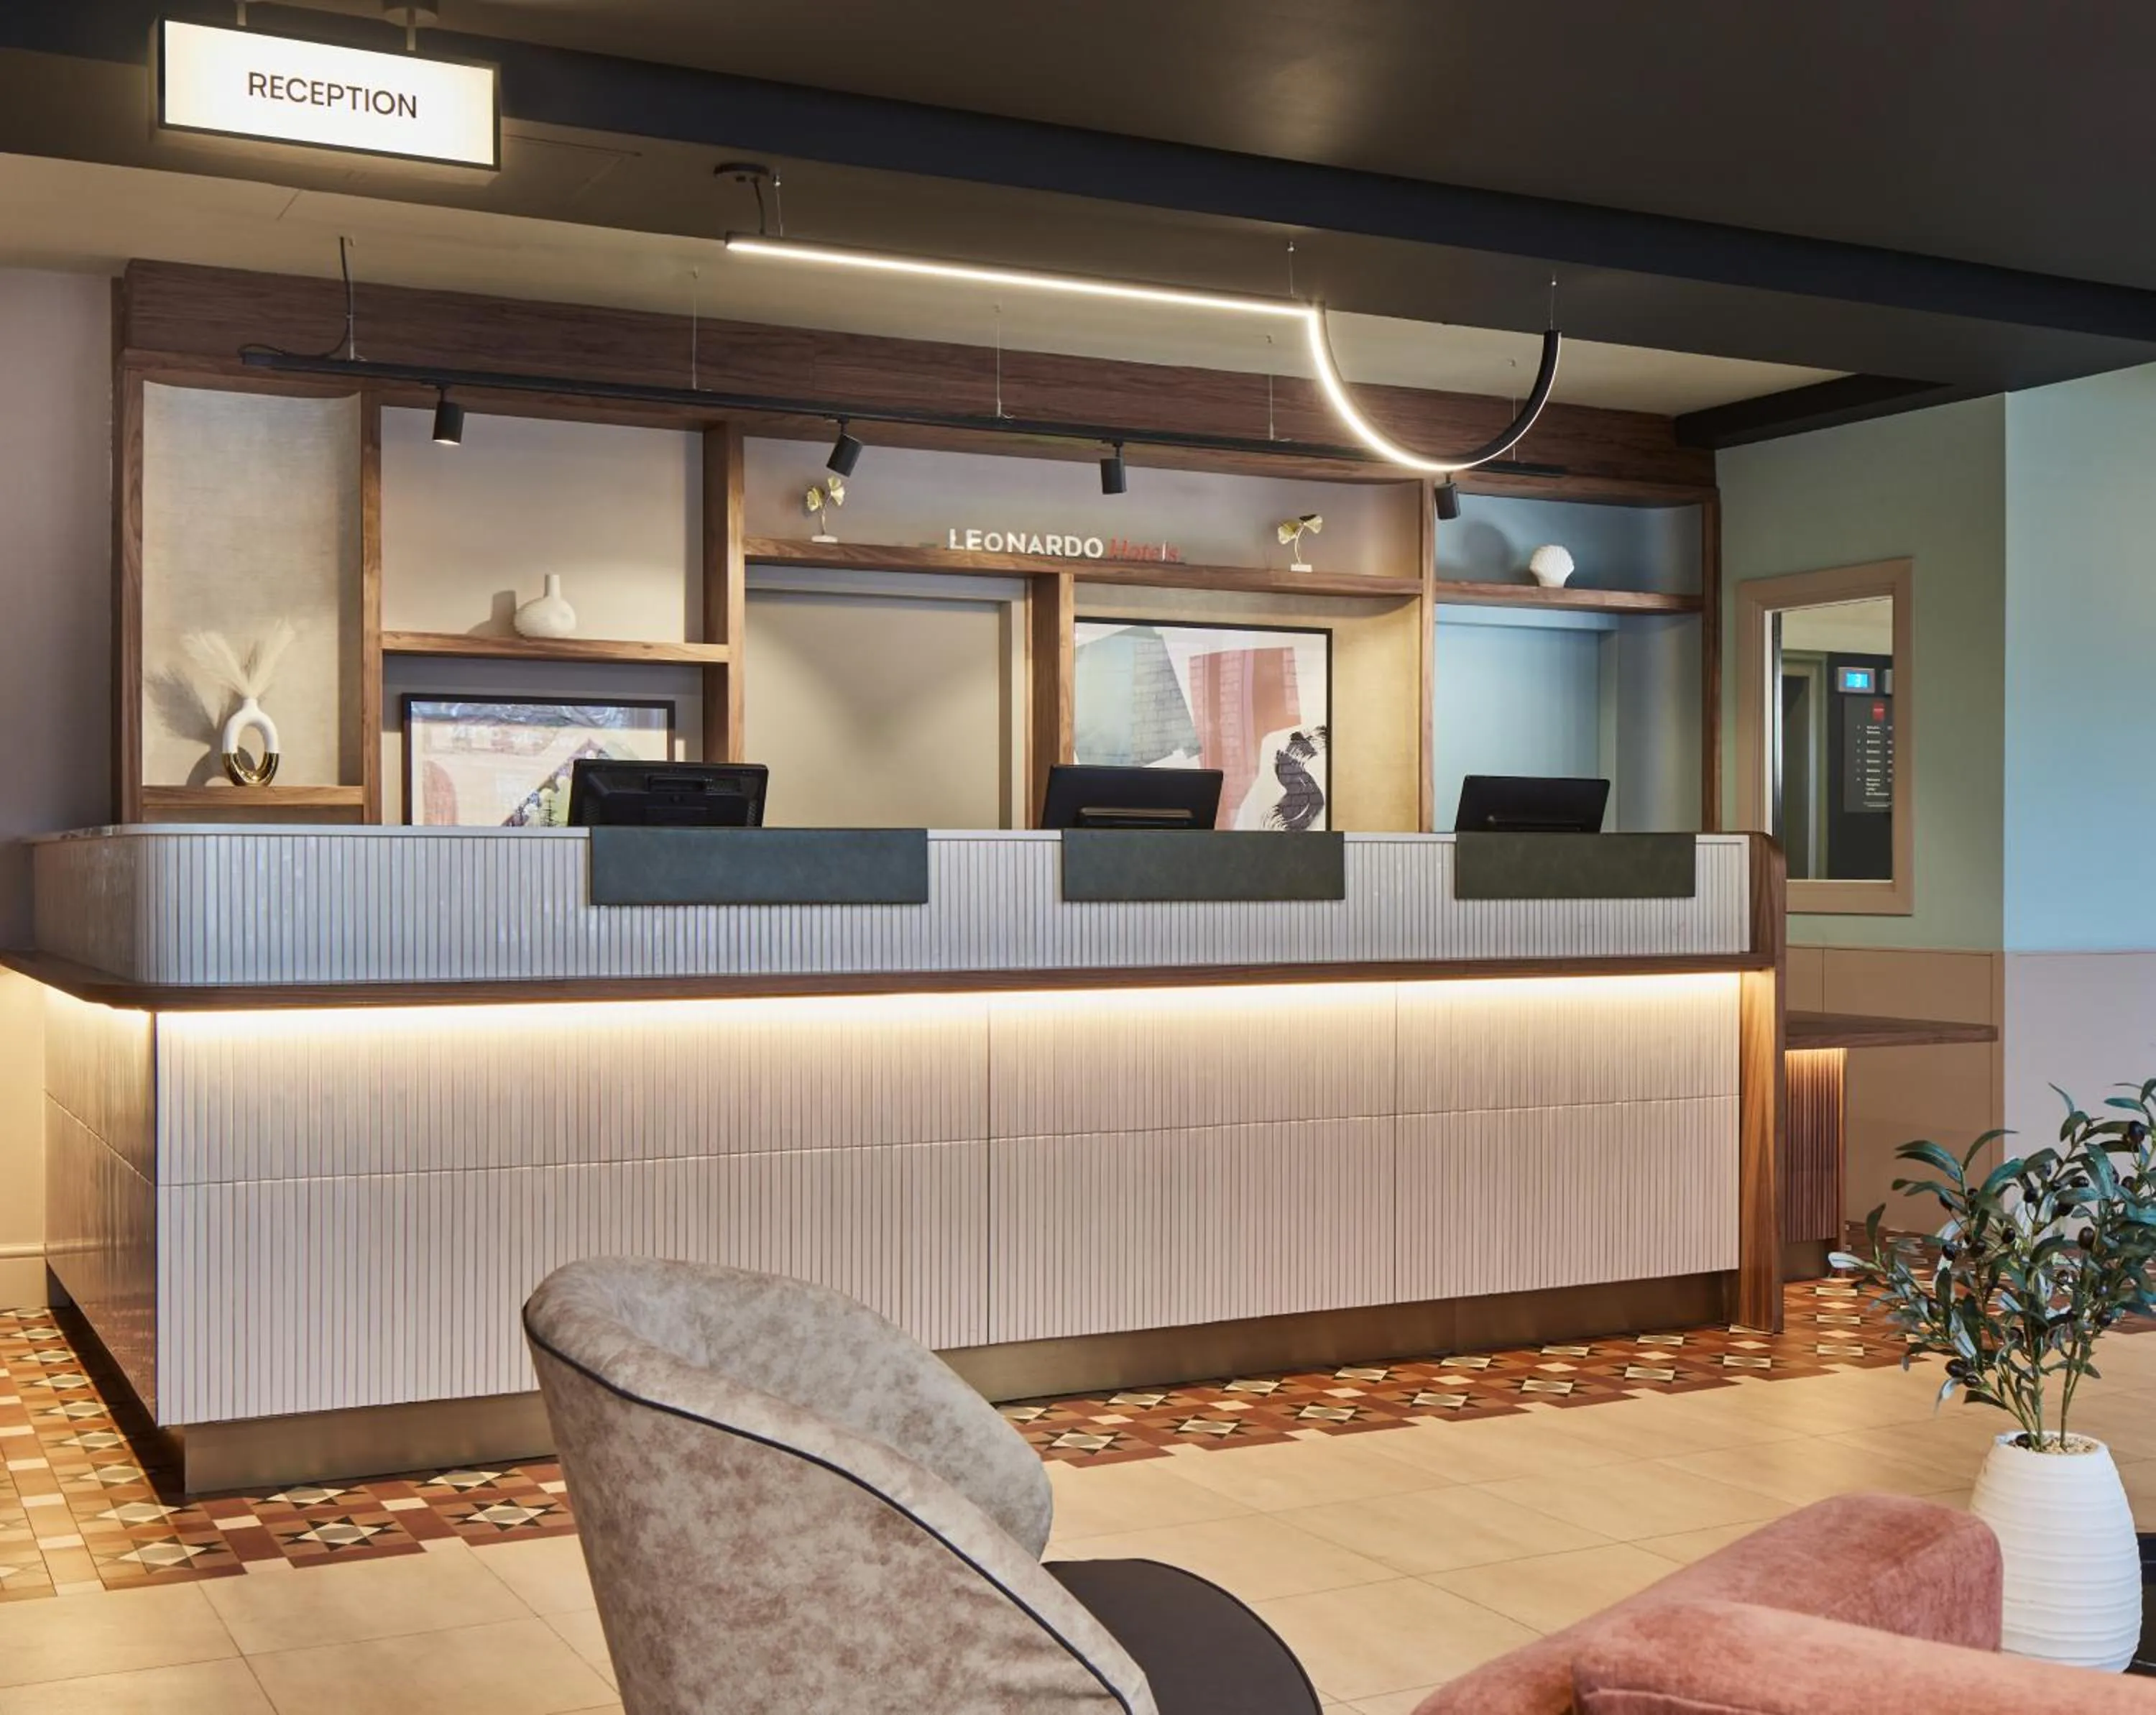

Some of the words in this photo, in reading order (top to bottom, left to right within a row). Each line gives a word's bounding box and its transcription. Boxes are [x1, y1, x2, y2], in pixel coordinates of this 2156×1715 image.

[248, 71, 417, 119] RECEPTION
[949, 528, 1103, 558] LEONARDO
[1109, 538, 1180, 561] Hotels
